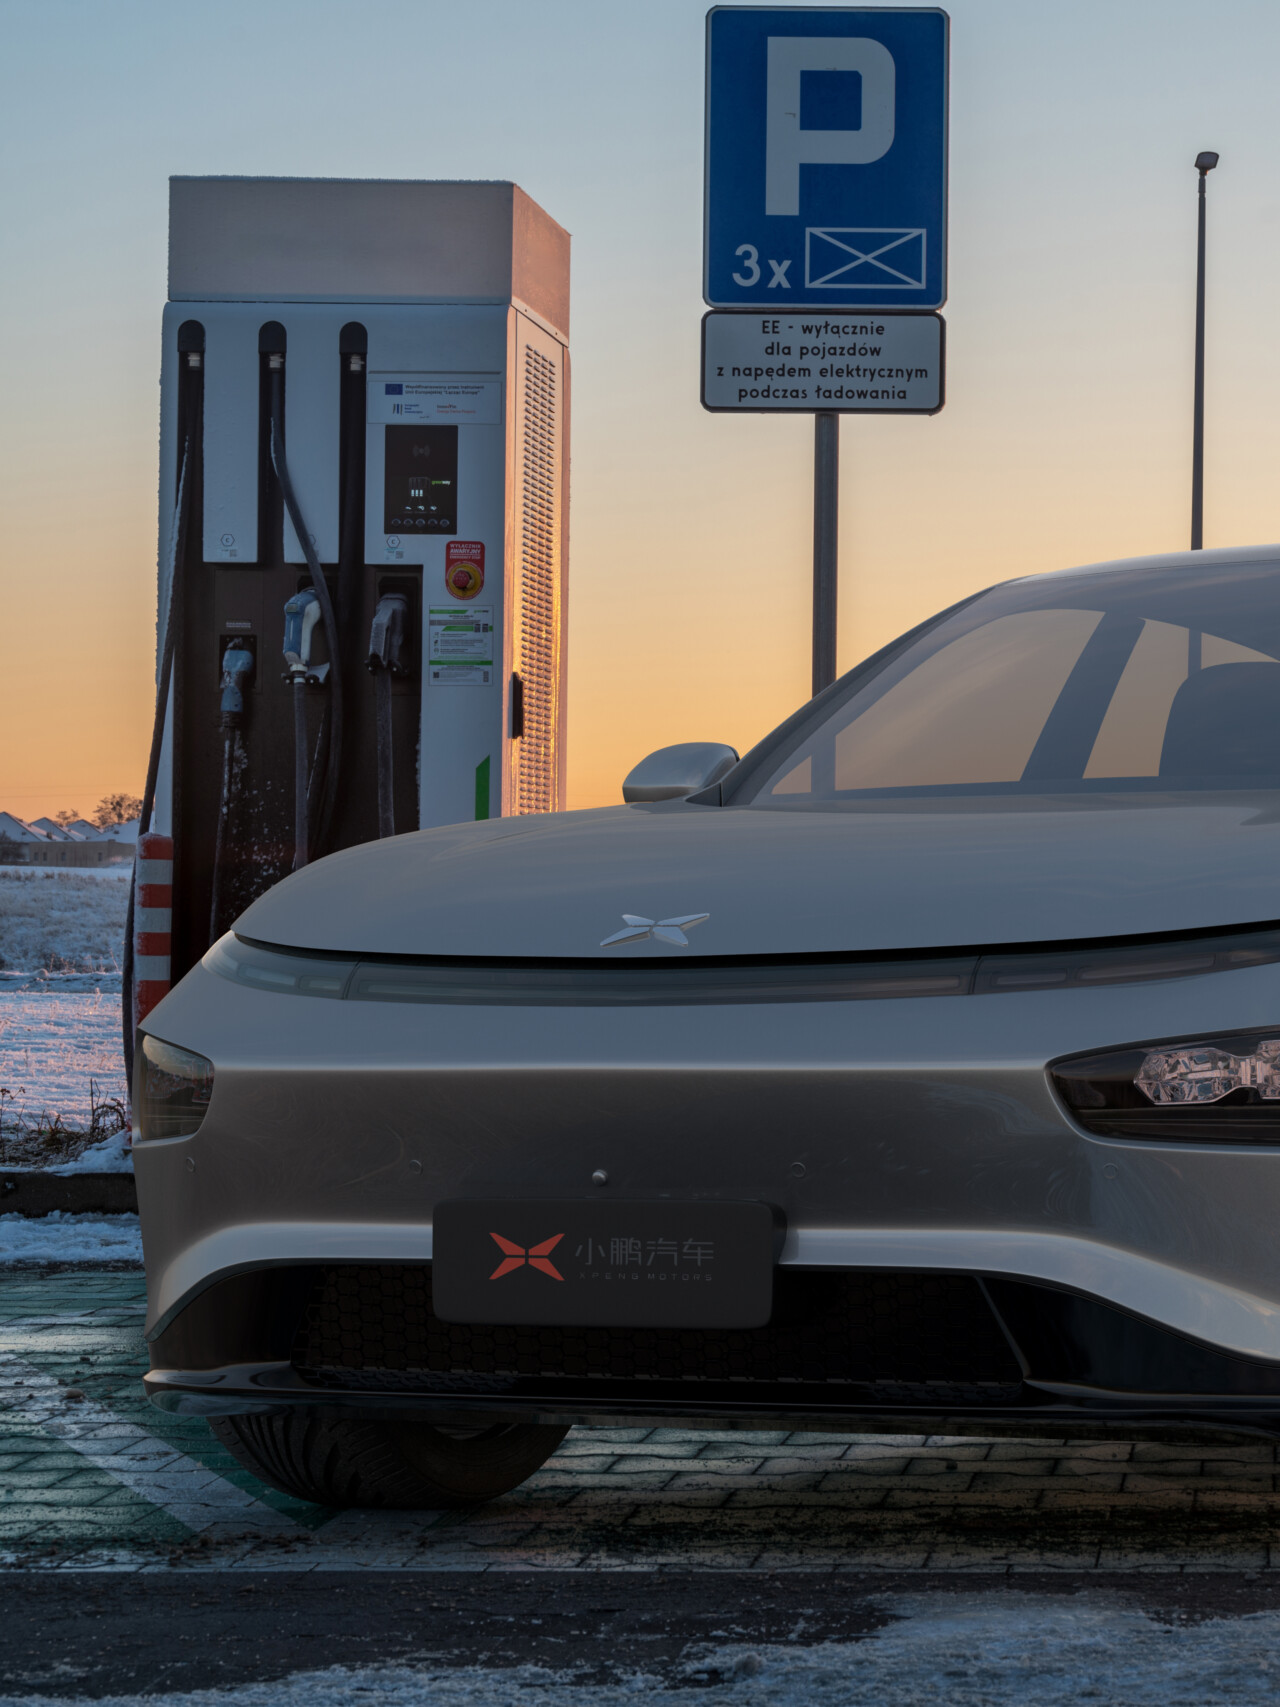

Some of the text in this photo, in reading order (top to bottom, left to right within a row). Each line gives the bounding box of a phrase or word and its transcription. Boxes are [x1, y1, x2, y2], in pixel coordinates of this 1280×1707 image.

[766, 36, 896, 216] P
[732, 243, 792, 289] 3x
[762, 320, 781, 335] EE
[801, 320, 885, 339] wyłącznie
[764, 342, 882, 361] dla pojazdów
[717, 364, 929, 383] z napędem elektrycznym
[738, 385, 908, 402] podczas ładowania
[575, 1237, 714, 1266] 小鹏汽车
[579, 1272, 713, 1281] XPENG MOTORS
